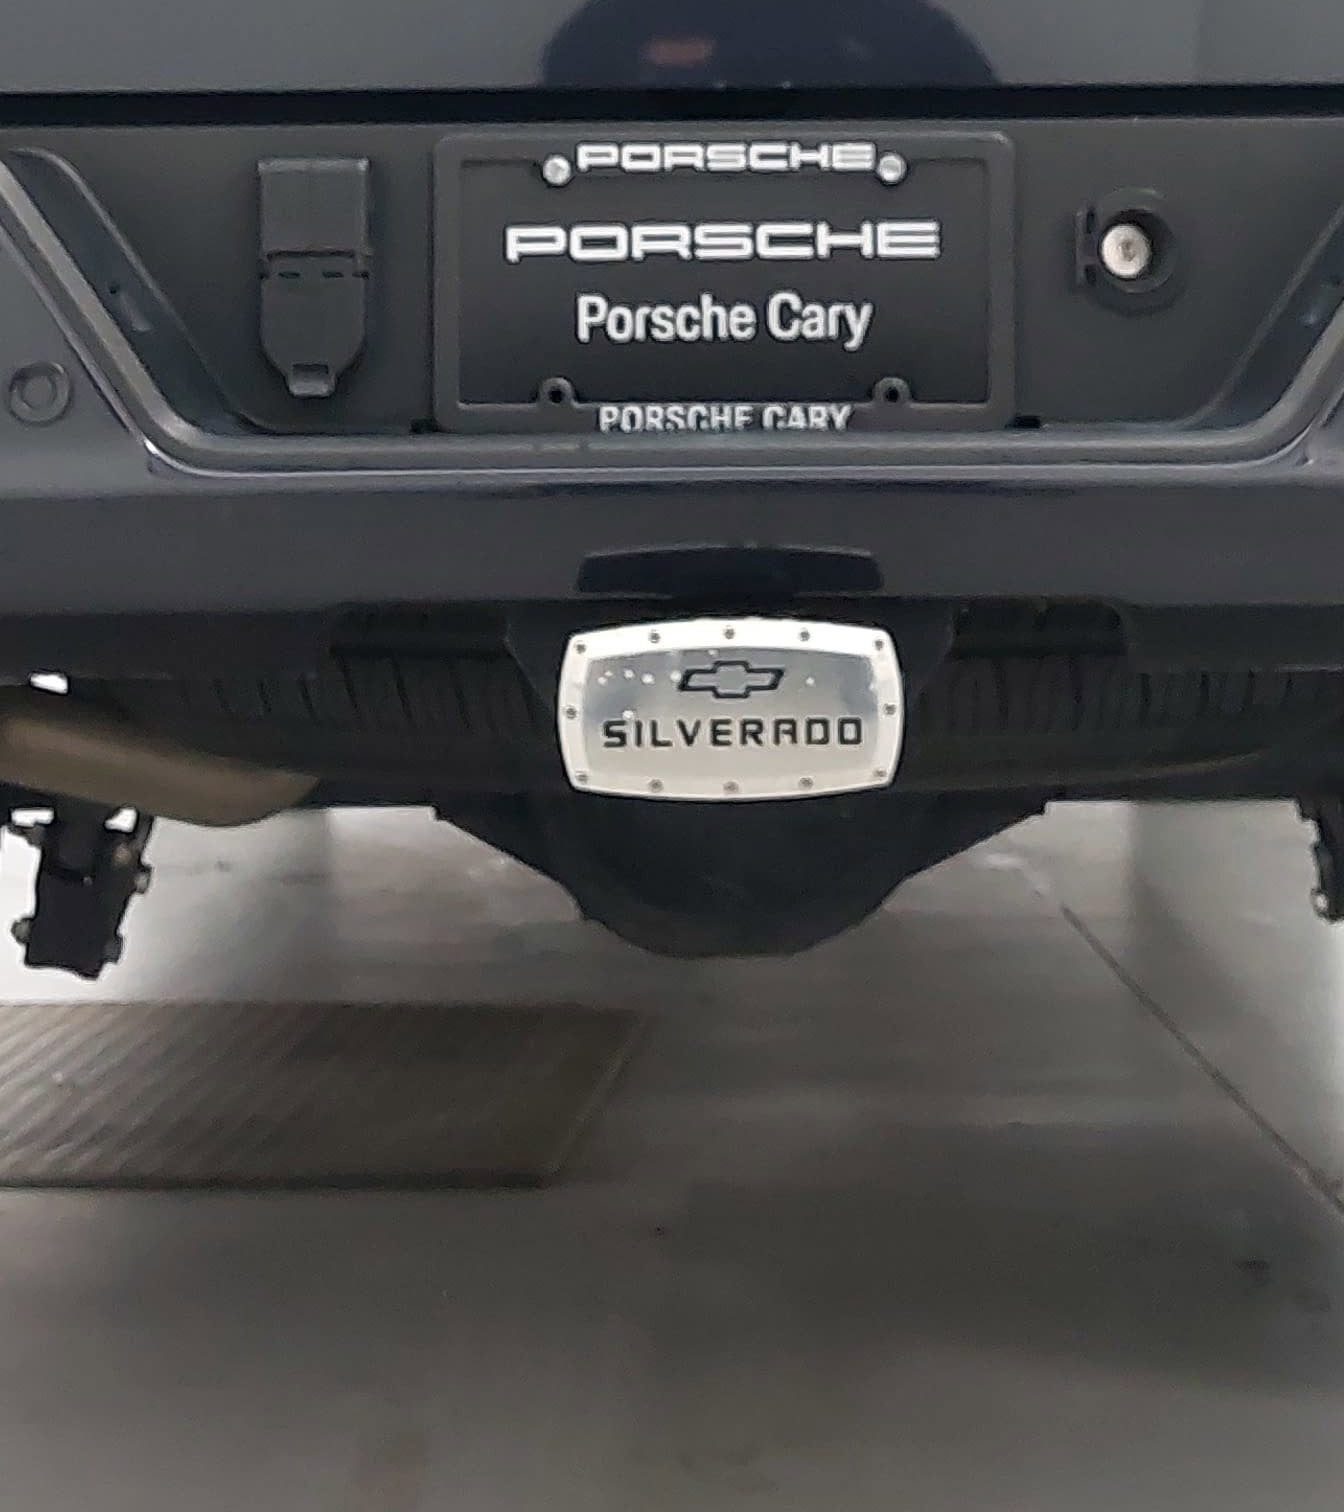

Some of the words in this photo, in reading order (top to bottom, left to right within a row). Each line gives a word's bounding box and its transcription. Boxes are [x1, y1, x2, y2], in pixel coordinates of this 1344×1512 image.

[576, 142, 877, 171] PORSCHE
[504, 221, 942, 263] PORSCHE
[575, 292, 755, 344] Porsche
[768, 291, 873, 352] Cary
[598, 405, 751, 432] PORSCHE
[763, 405, 854, 432] CARY
[602, 717, 864, 749] SILVERADO
